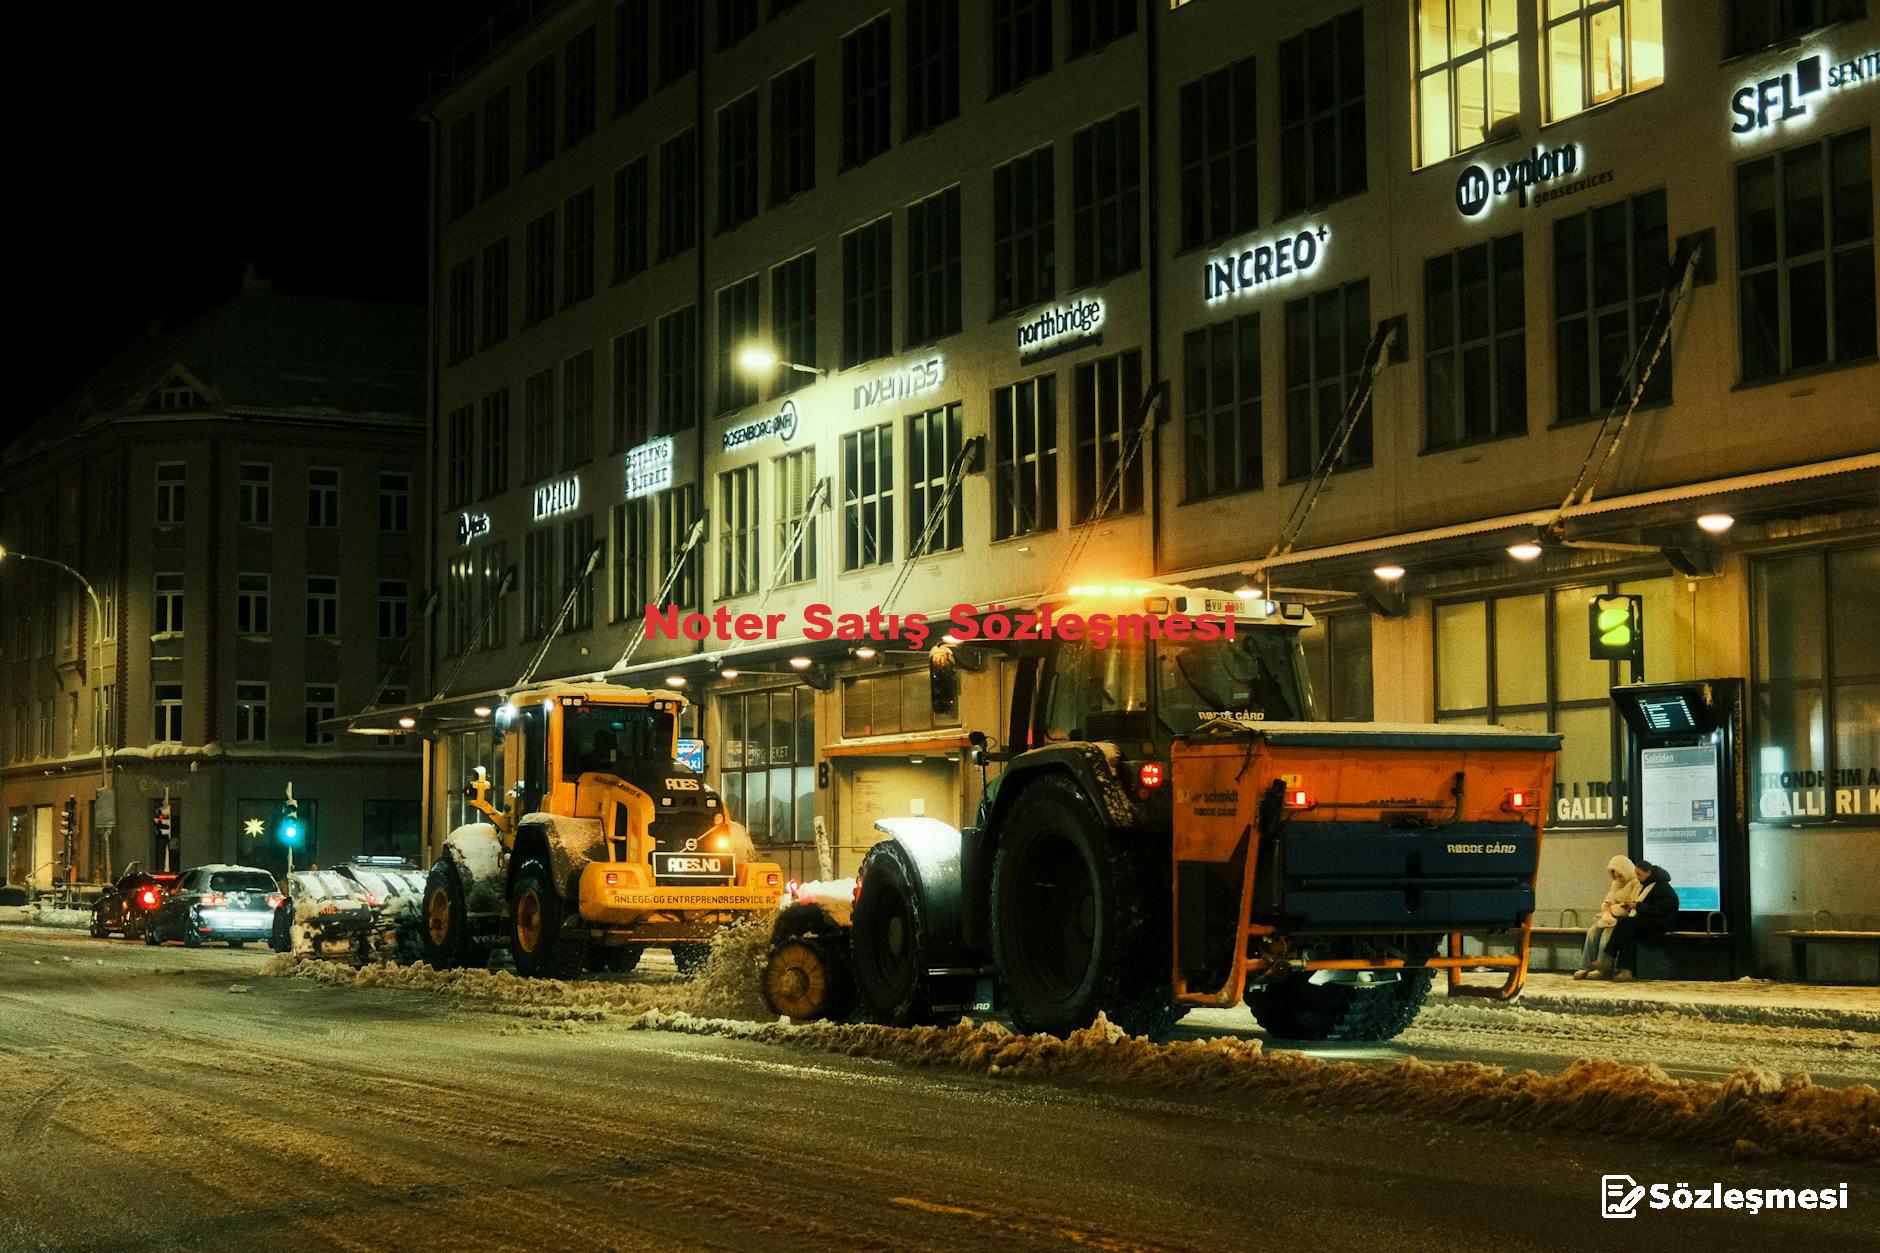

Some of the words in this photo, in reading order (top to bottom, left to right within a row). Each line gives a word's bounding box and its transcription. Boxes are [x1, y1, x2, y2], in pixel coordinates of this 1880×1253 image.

[1731, 73, 1806, 133] SFL
[1534, 170, 1614, 208] geoservices
[723, 420, 773, 449] ROSENBORG
[1447, 844, 1484, 854] RØDDE
[1485, 841, 1516, 854] GÅRD
[614, 895, 650, 904] ANLEGG
[653, 895, 665, 904] OG
